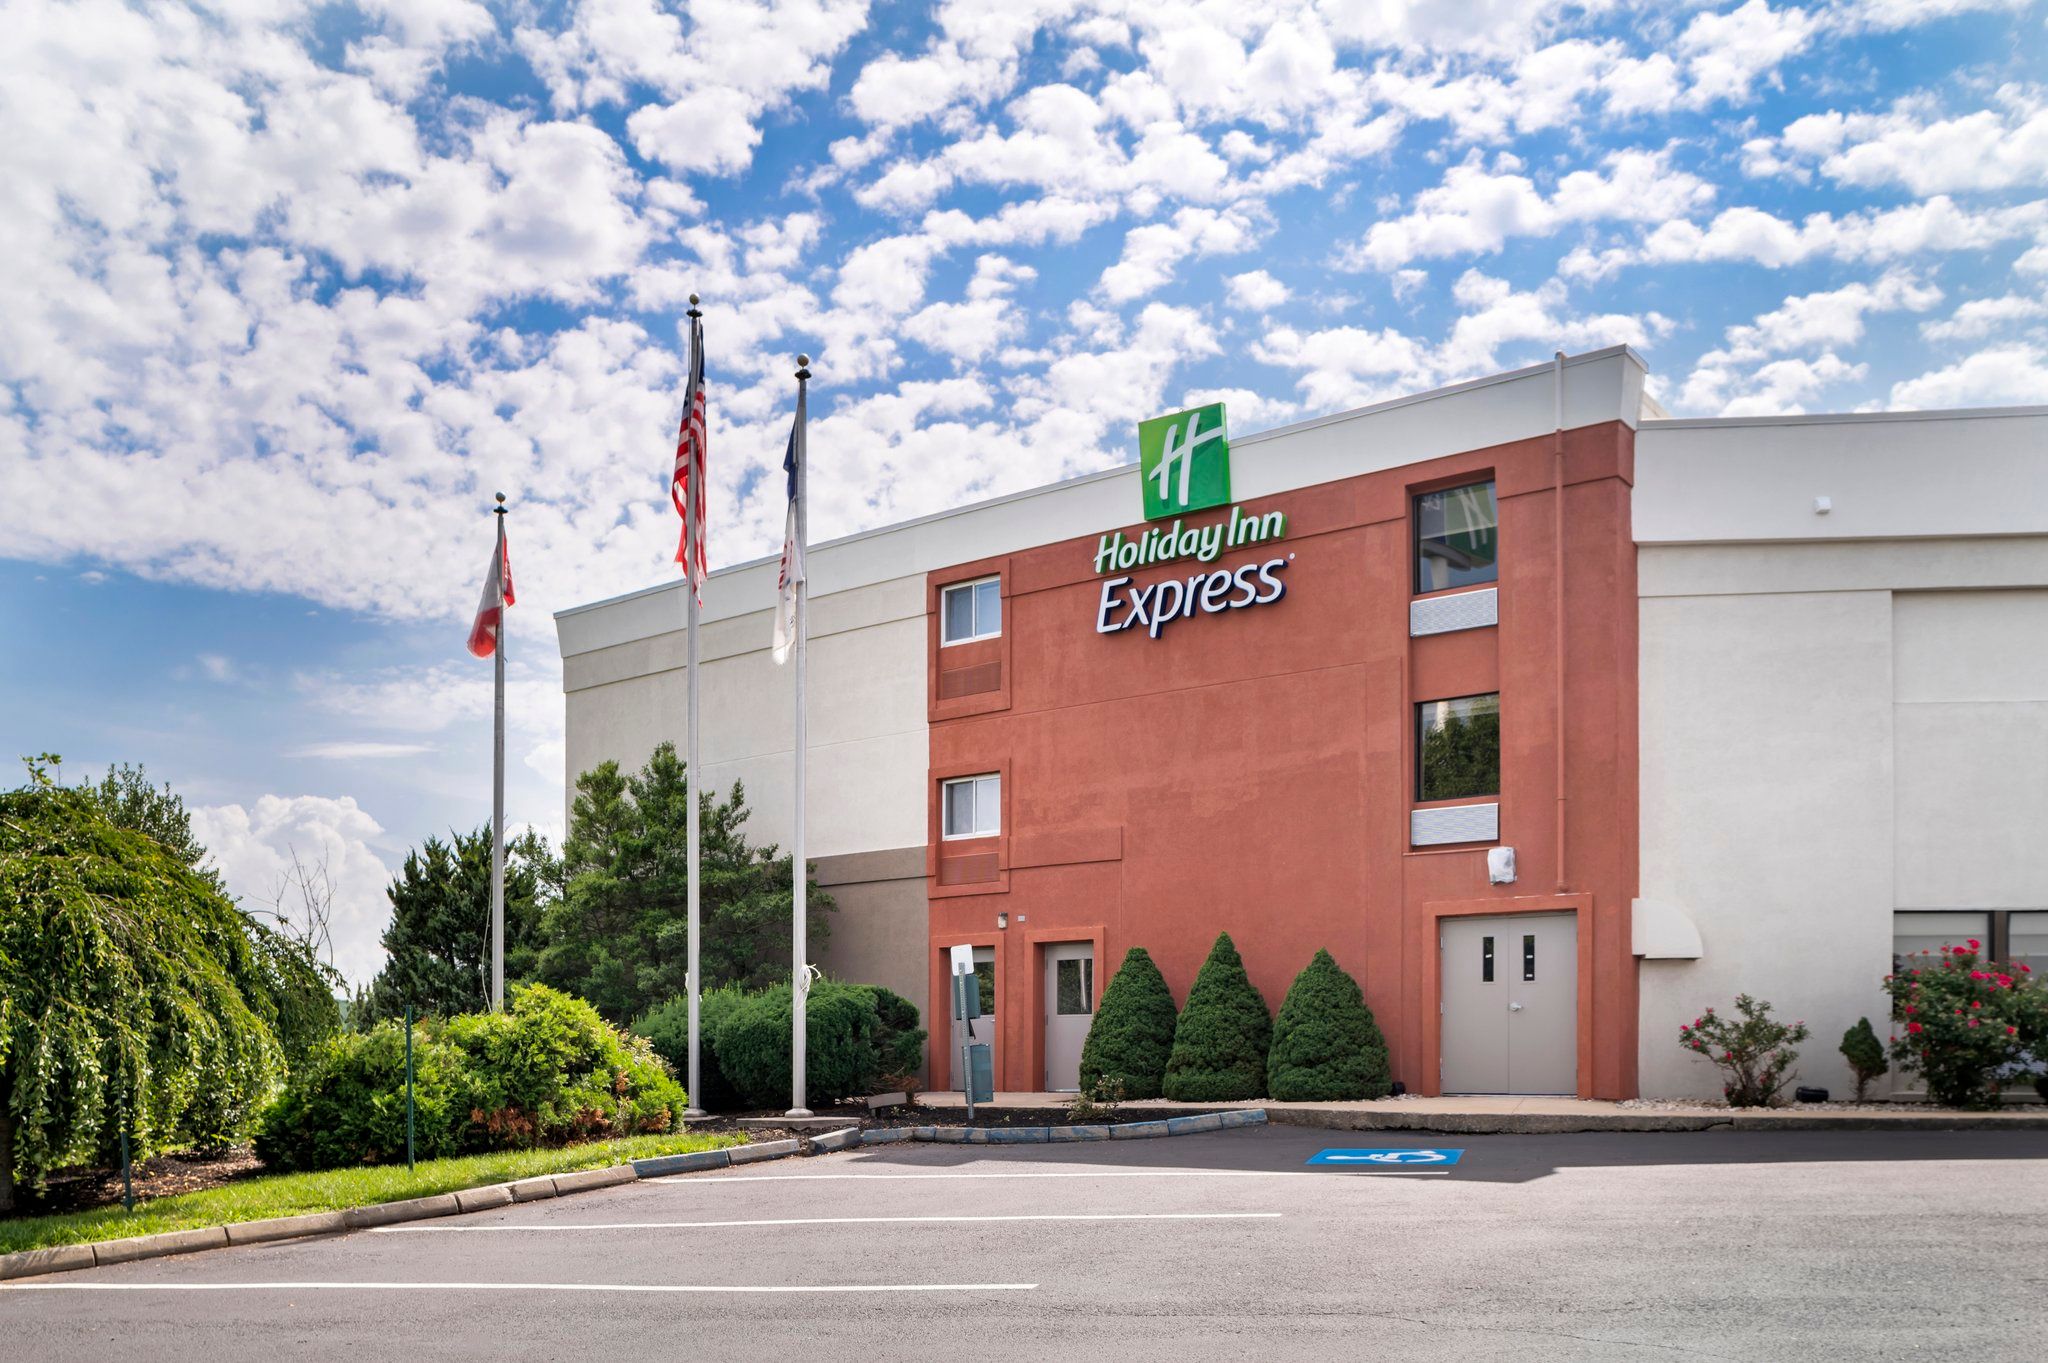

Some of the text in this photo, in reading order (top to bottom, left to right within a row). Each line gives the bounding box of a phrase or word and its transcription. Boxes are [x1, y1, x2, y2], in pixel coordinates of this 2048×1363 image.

[1094, 506, 1286, 574] Holiday Inn
[1096, 558, 1288, 639] Express
